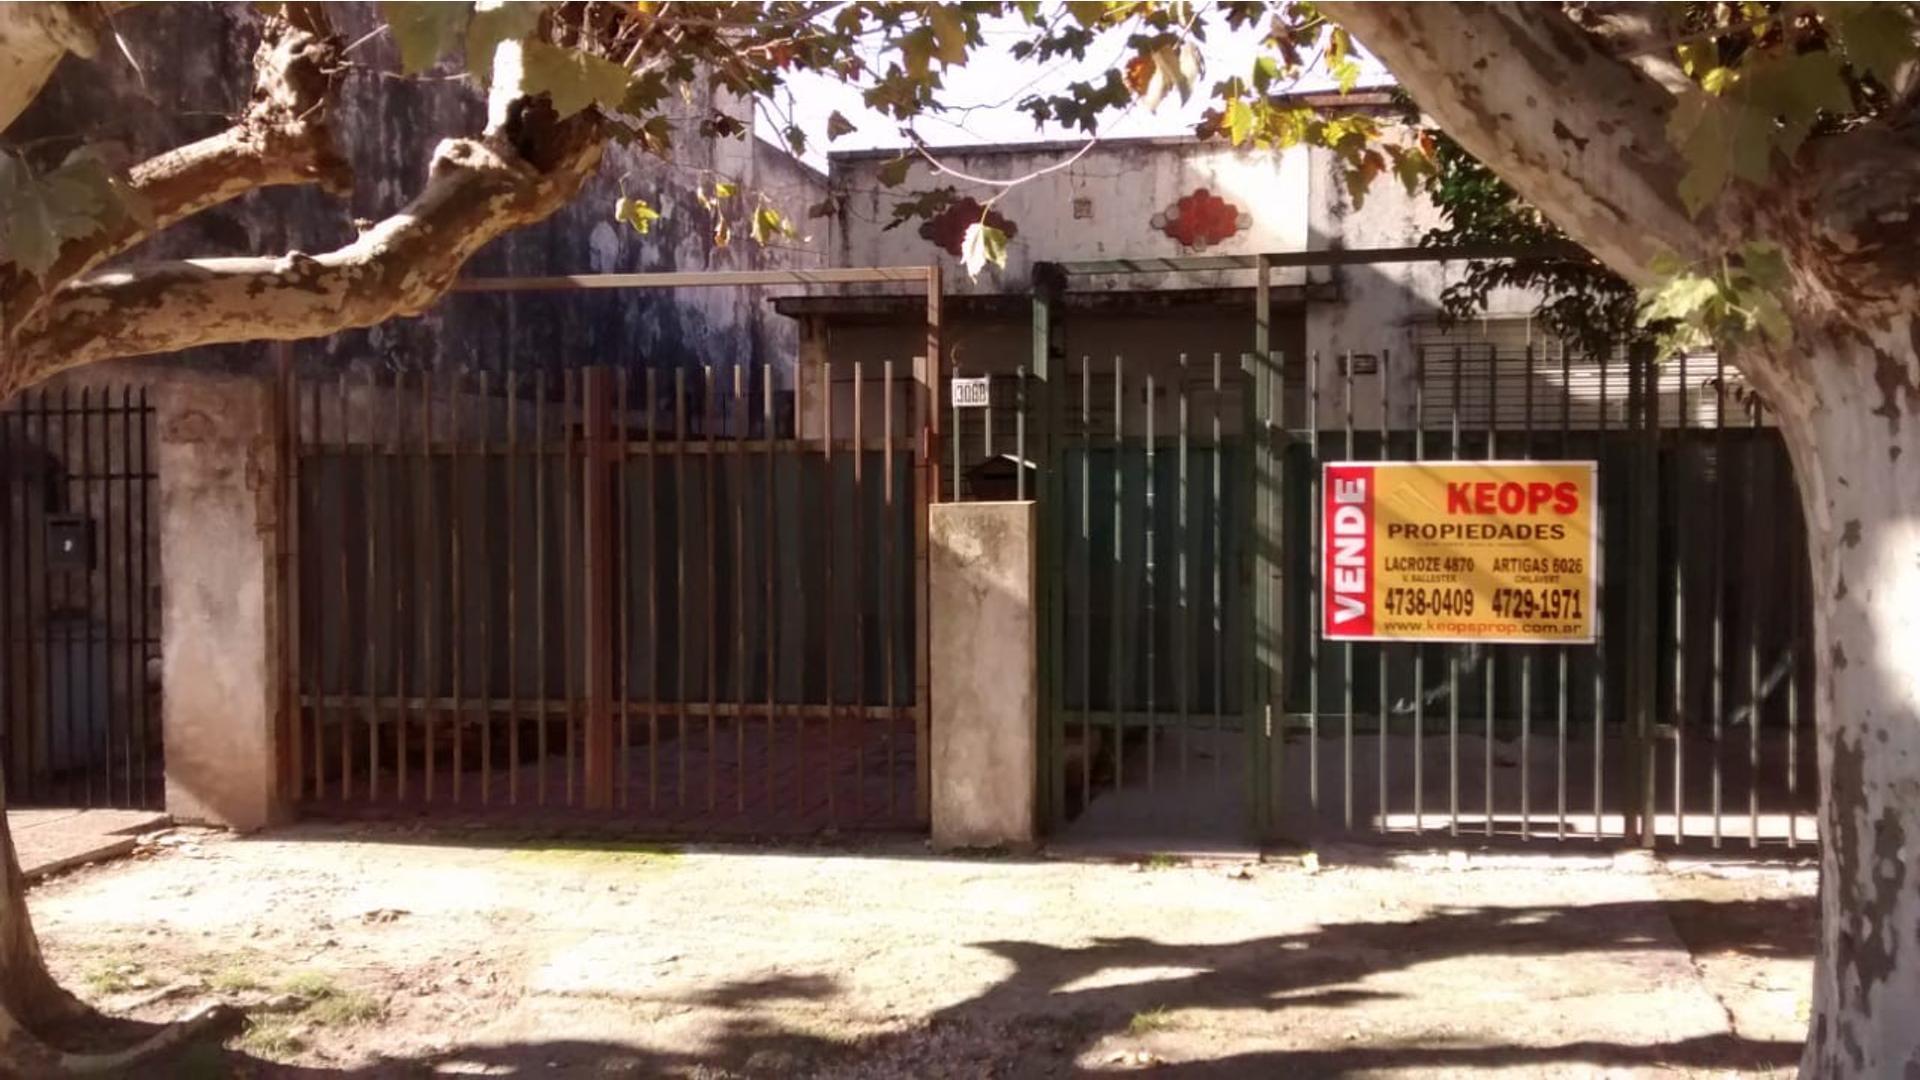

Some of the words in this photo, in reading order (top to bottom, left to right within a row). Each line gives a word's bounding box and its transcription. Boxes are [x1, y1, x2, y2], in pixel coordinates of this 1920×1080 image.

[1447, 482, 1579, 515] KEOPS
[1387, 524, 1565, 540] PROPIEDADES
[1334, 478, 1366, 624] VENDE
[1384, 557, 1440, 572] LACROZE
[1493, 557, 1549, 573] ARTIGAS
[1384, 588, 1474, 616] 4738-0409
[1492, 588, 1582, 619] 4729-1971
[1384, 620, 1582, 635] www.keopsprop.com.ar
